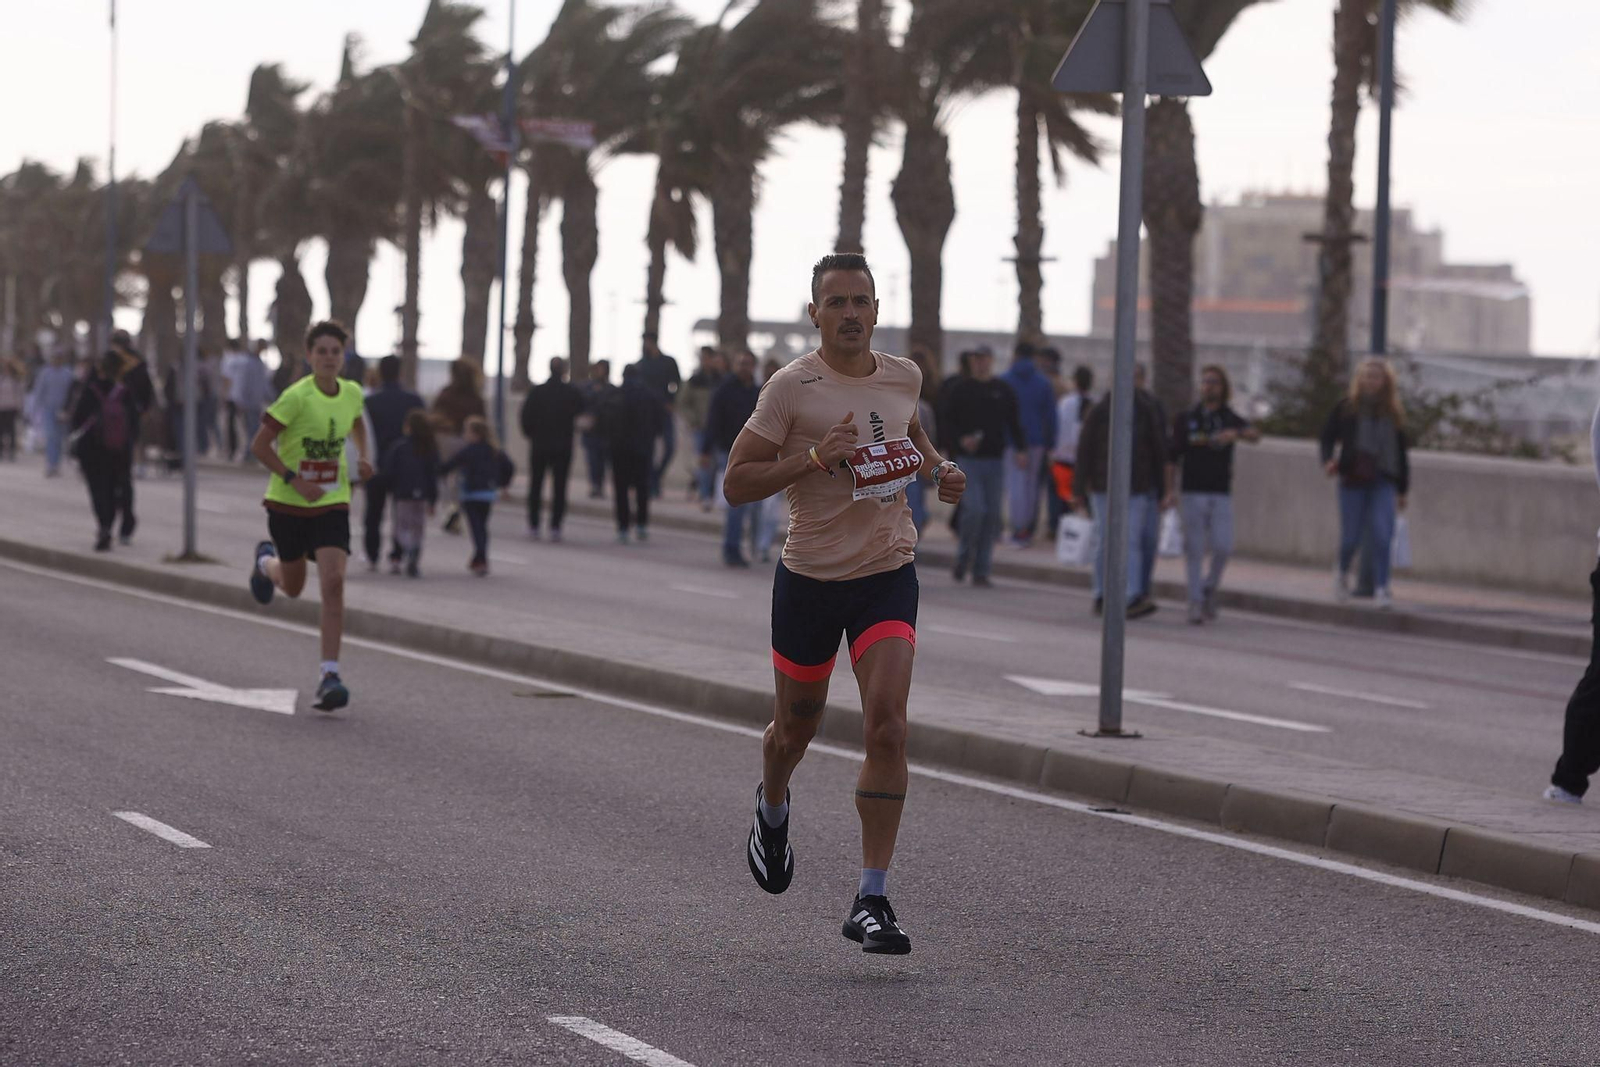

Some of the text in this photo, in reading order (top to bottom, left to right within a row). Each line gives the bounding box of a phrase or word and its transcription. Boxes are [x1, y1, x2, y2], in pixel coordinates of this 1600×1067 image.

[854, 461, 885, 472] BRUNCH
[885, 454, 920, 472] 1319
[860, 469, 876, 480] RUN
